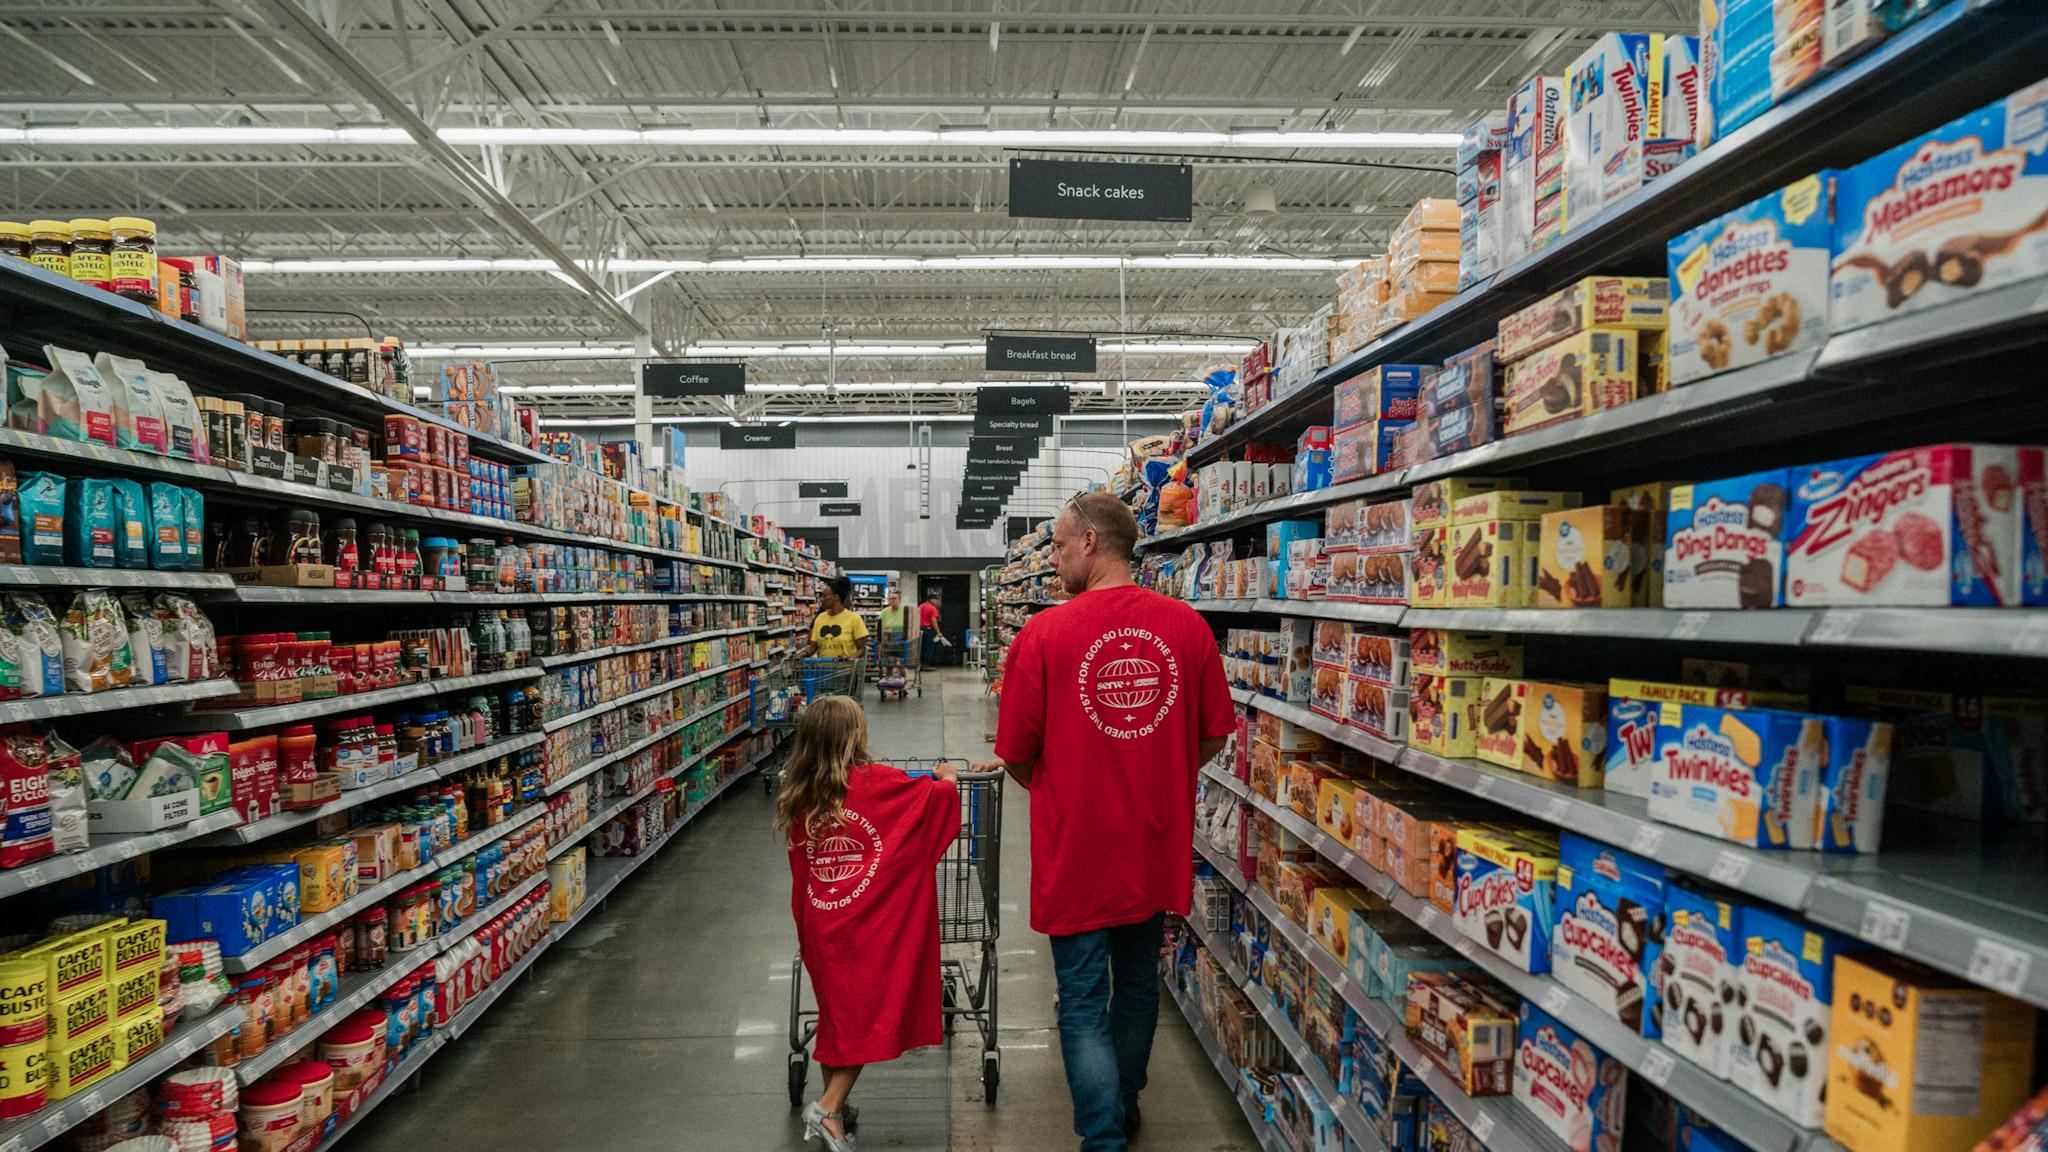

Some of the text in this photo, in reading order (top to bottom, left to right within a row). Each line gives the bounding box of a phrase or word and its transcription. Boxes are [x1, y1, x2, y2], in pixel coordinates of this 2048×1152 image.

[1611, 62, 1643, 142] Twinkies
[1057, 182, 1144, 199] Snack cakes
[1867, 161, 2016, 245] Meltamors
[1695, 247, 1789, 300] donettes
[1006, 349, 1077, 360] Breakfast bread
[679, 375, 709, 384] Coffee
[1011, 397, 1036, 407] Bagels
[989, 421, 1019, 429] Specialty
[1805, 472, 1928, 556] Zingers
[1676, 526, 1768, 562] Ding Dongs
[1079, 661, 1090, 684] FOR
[1085, 639, 1103, 660] GOD
[1102, 630, 1117, 643] SO
[1118, 628, 1152, 640] LOVED
[1153, 636, 1171, 656] THE
[1097, 680, 1124, 691] serve
[1165, 684, 1179, 706] FOR
[1640, 685, 1707, 702] FAMILY PACK
[1104, 726, 1138, 739] LOVED
[1139, 724, 1154, 737] SO
[9, 774, 49, 794] EIGH
[232, 765, 257, 782] Folgers
[1666, 749, 1750, 798] Twinkies
[1778, 747, 1799, 824] Twinkies
[164, 808, 189, 820] FILTERS
[171, 799, 189, 809] CONE
[859, 816, 877, 836] THE
[867, 857, 880, 878] FOR
[852, 878, 871, 899] GOD
[811, 897, 838, 910] LOVED
[839, 895, 852, 907] SO
[117, 928, 149, 949] CAFE
[58, 946, 89, 969] CAFE
[116, 937, 161, 963] BUSTELO
[58, 954, 103, 984] BUSTELO
[1747, 956, 1811, 1001] Cupcakes
[118, 973, 145, 995] CAFE
[67, 995, 96, 1017] CAFE
[117, 981, 156, 1013] BUSTELO
[67, 1000, 108, 1032] BUSTELO
[69, 1041, 98, 1063] CAFE
